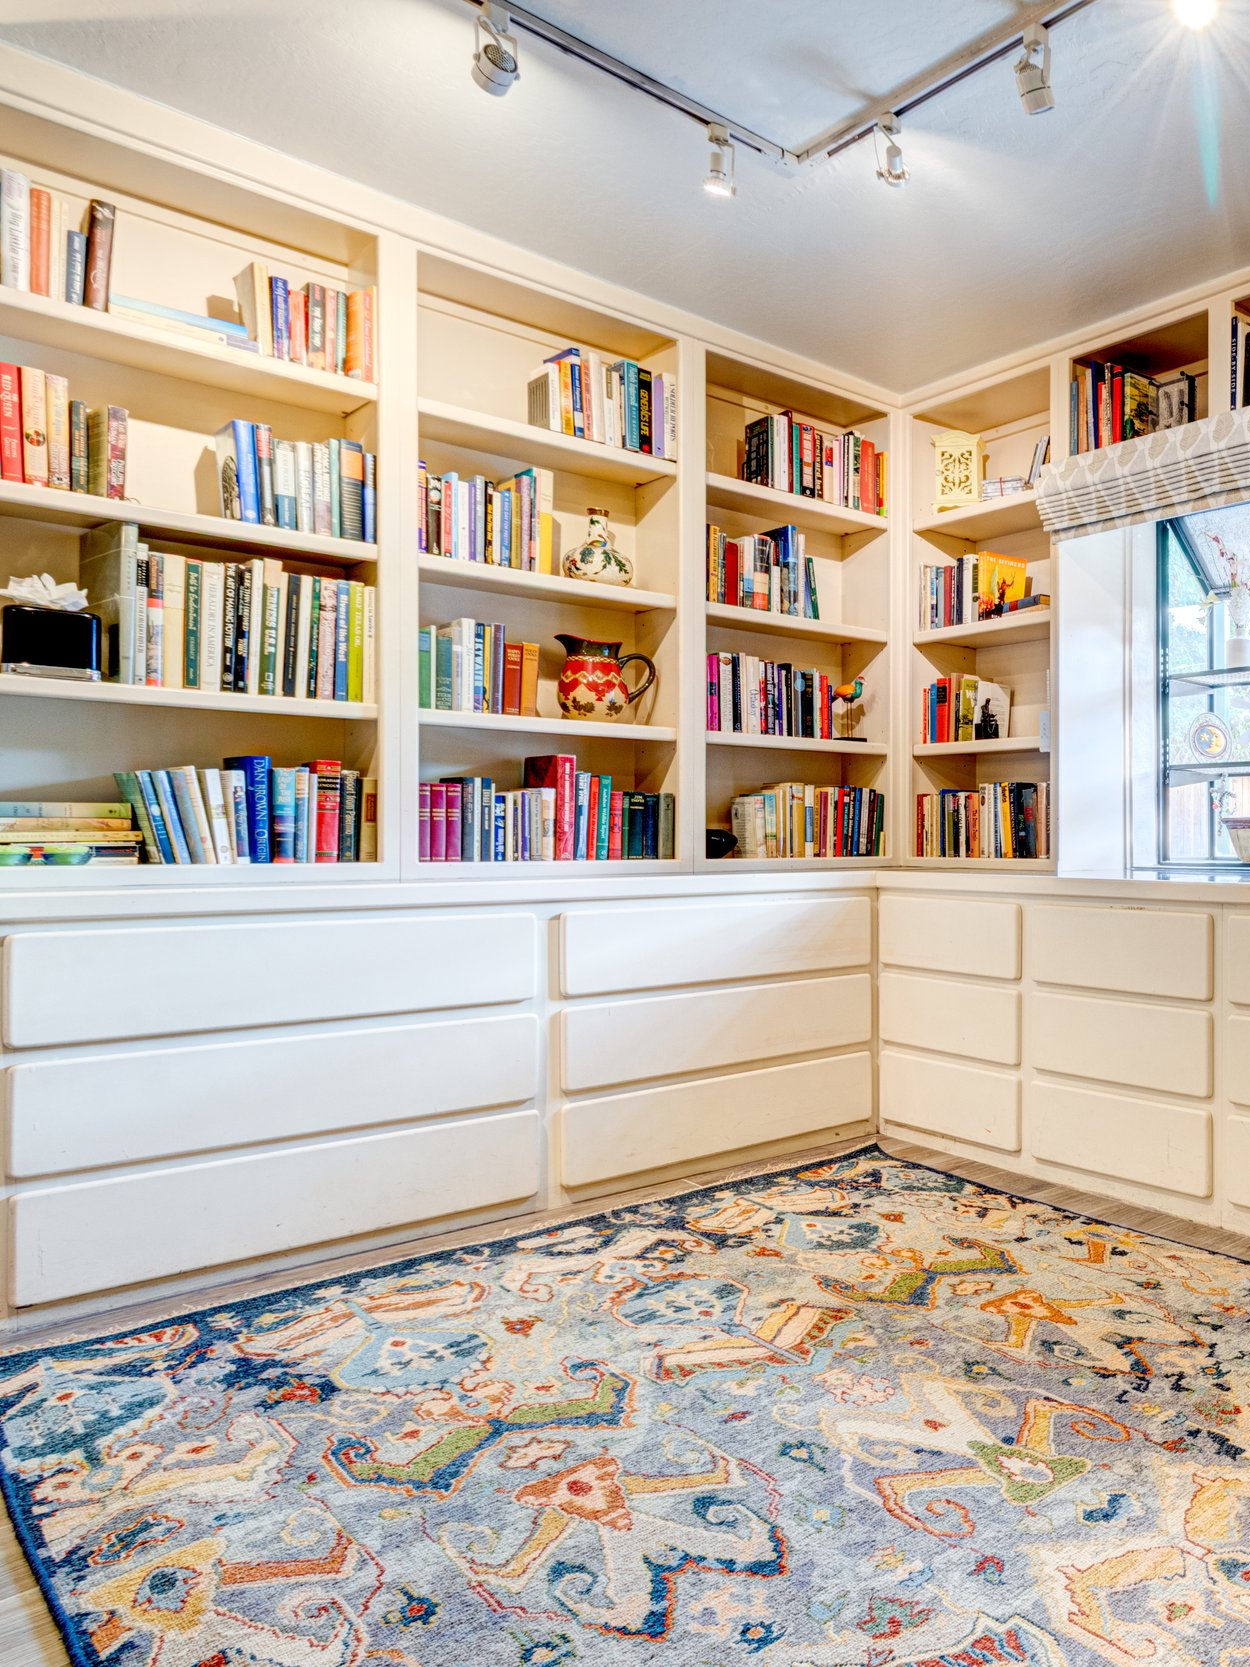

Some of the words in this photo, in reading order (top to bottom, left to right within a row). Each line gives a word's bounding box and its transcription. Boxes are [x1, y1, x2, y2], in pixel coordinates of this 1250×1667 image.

[2, 375, 12, 392] RED
[2, 391, 13, 417] QUEEN
[640, 422, 649, 437] LIFE
[226, 565, 234, 576] THE
[226, 576, 234, 589] ART
[226, 588, 234, 598] OF
[189, 593, 198, 630] Enchantment
[208, 583, 216, 622] HERALDRY
[225, 598, 234, 622] MAKING
[339, 595, 347, 620] Rivers
[208, 623, 216, 631] IN
[225, 623, 233, 647] POTTERY
[339, 628, 347, 642] the
[207, 632, 216, 667] AMERICA
[338, 643, 346, 662] West
[254, 759, 265, 781] DAN
[345, 774, 356, 794] Report
[254, 784, 266, 820] BROWN
[345, 795, 355, 810] from
[345, 810, 355, 835] Palermo
[255, 829, 267, 862] ORIGIN
